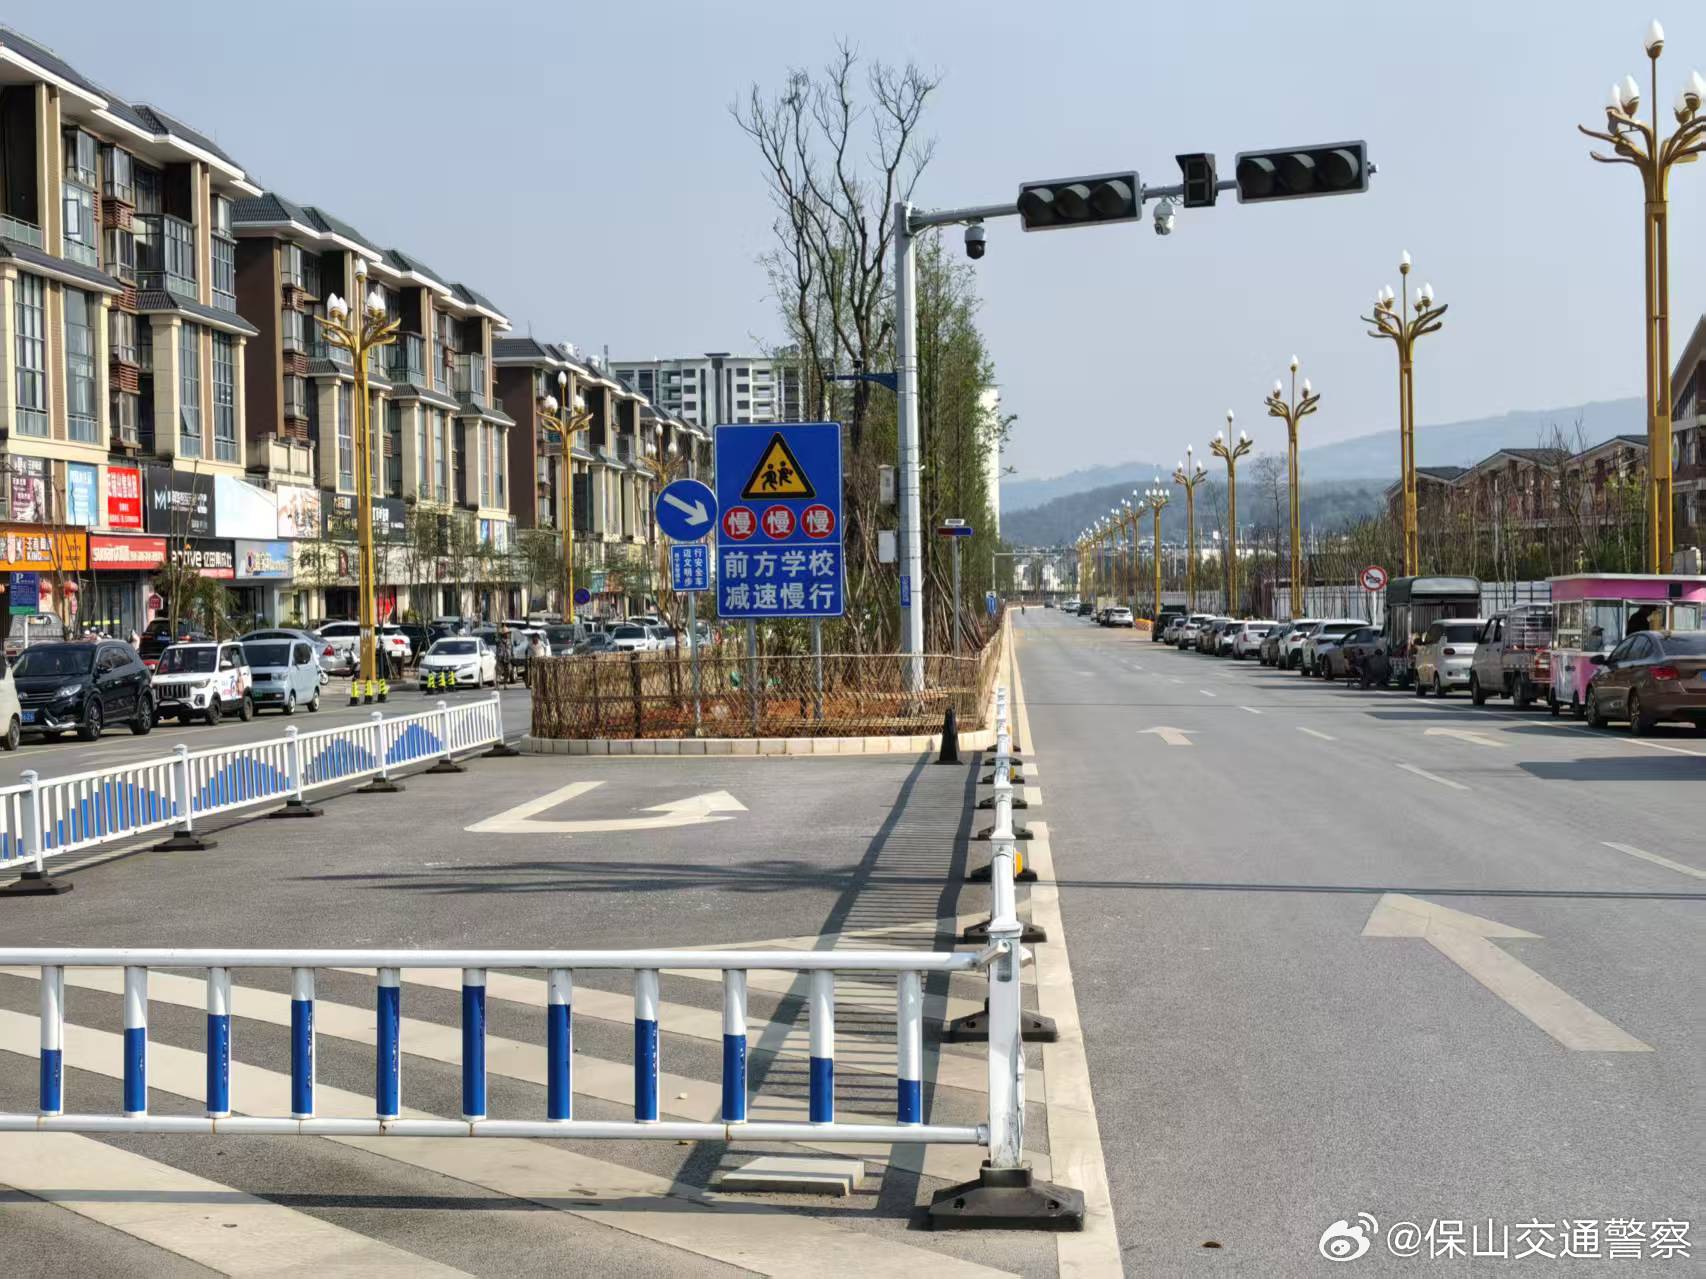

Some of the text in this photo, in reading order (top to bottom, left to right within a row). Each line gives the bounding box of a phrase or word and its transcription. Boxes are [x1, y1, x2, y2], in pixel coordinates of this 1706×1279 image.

[728, 510, 830, 535] 慢 慢 慢
[724, 549, 835, 579] 前方学校
[725, 582, 835, 610] 减速慢行
